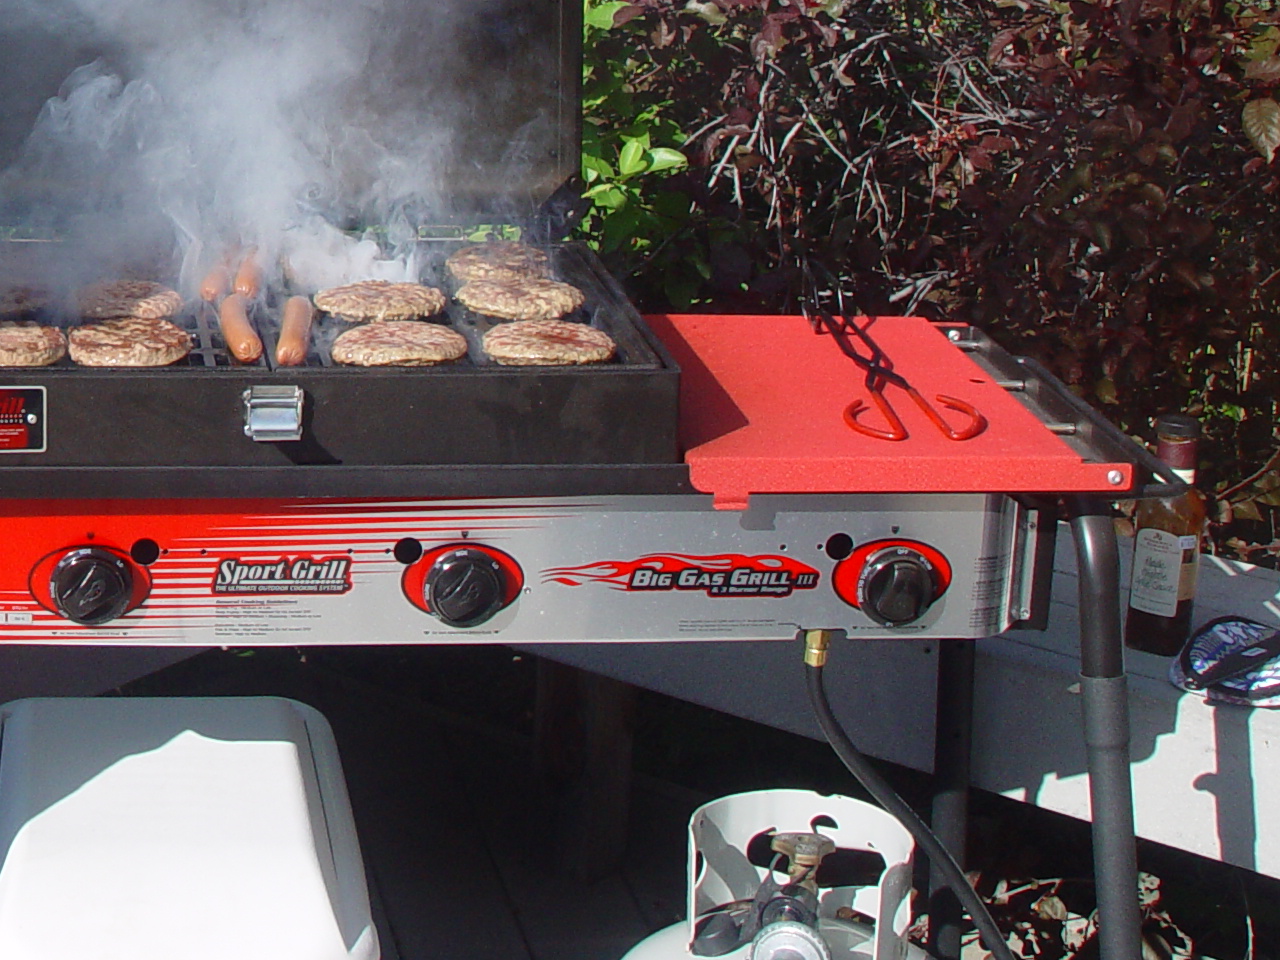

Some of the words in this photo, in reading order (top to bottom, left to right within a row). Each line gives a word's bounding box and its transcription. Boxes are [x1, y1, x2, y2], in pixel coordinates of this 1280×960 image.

[217, 559, 286, 585] Sport
[291, 559, 348, 579] Grill
[631, 569, 673, 587] BIG
[678, 569, 725, 586] GAS
[730, 568, 791, 585] GRILL
[796, 574, 816, 585] III
